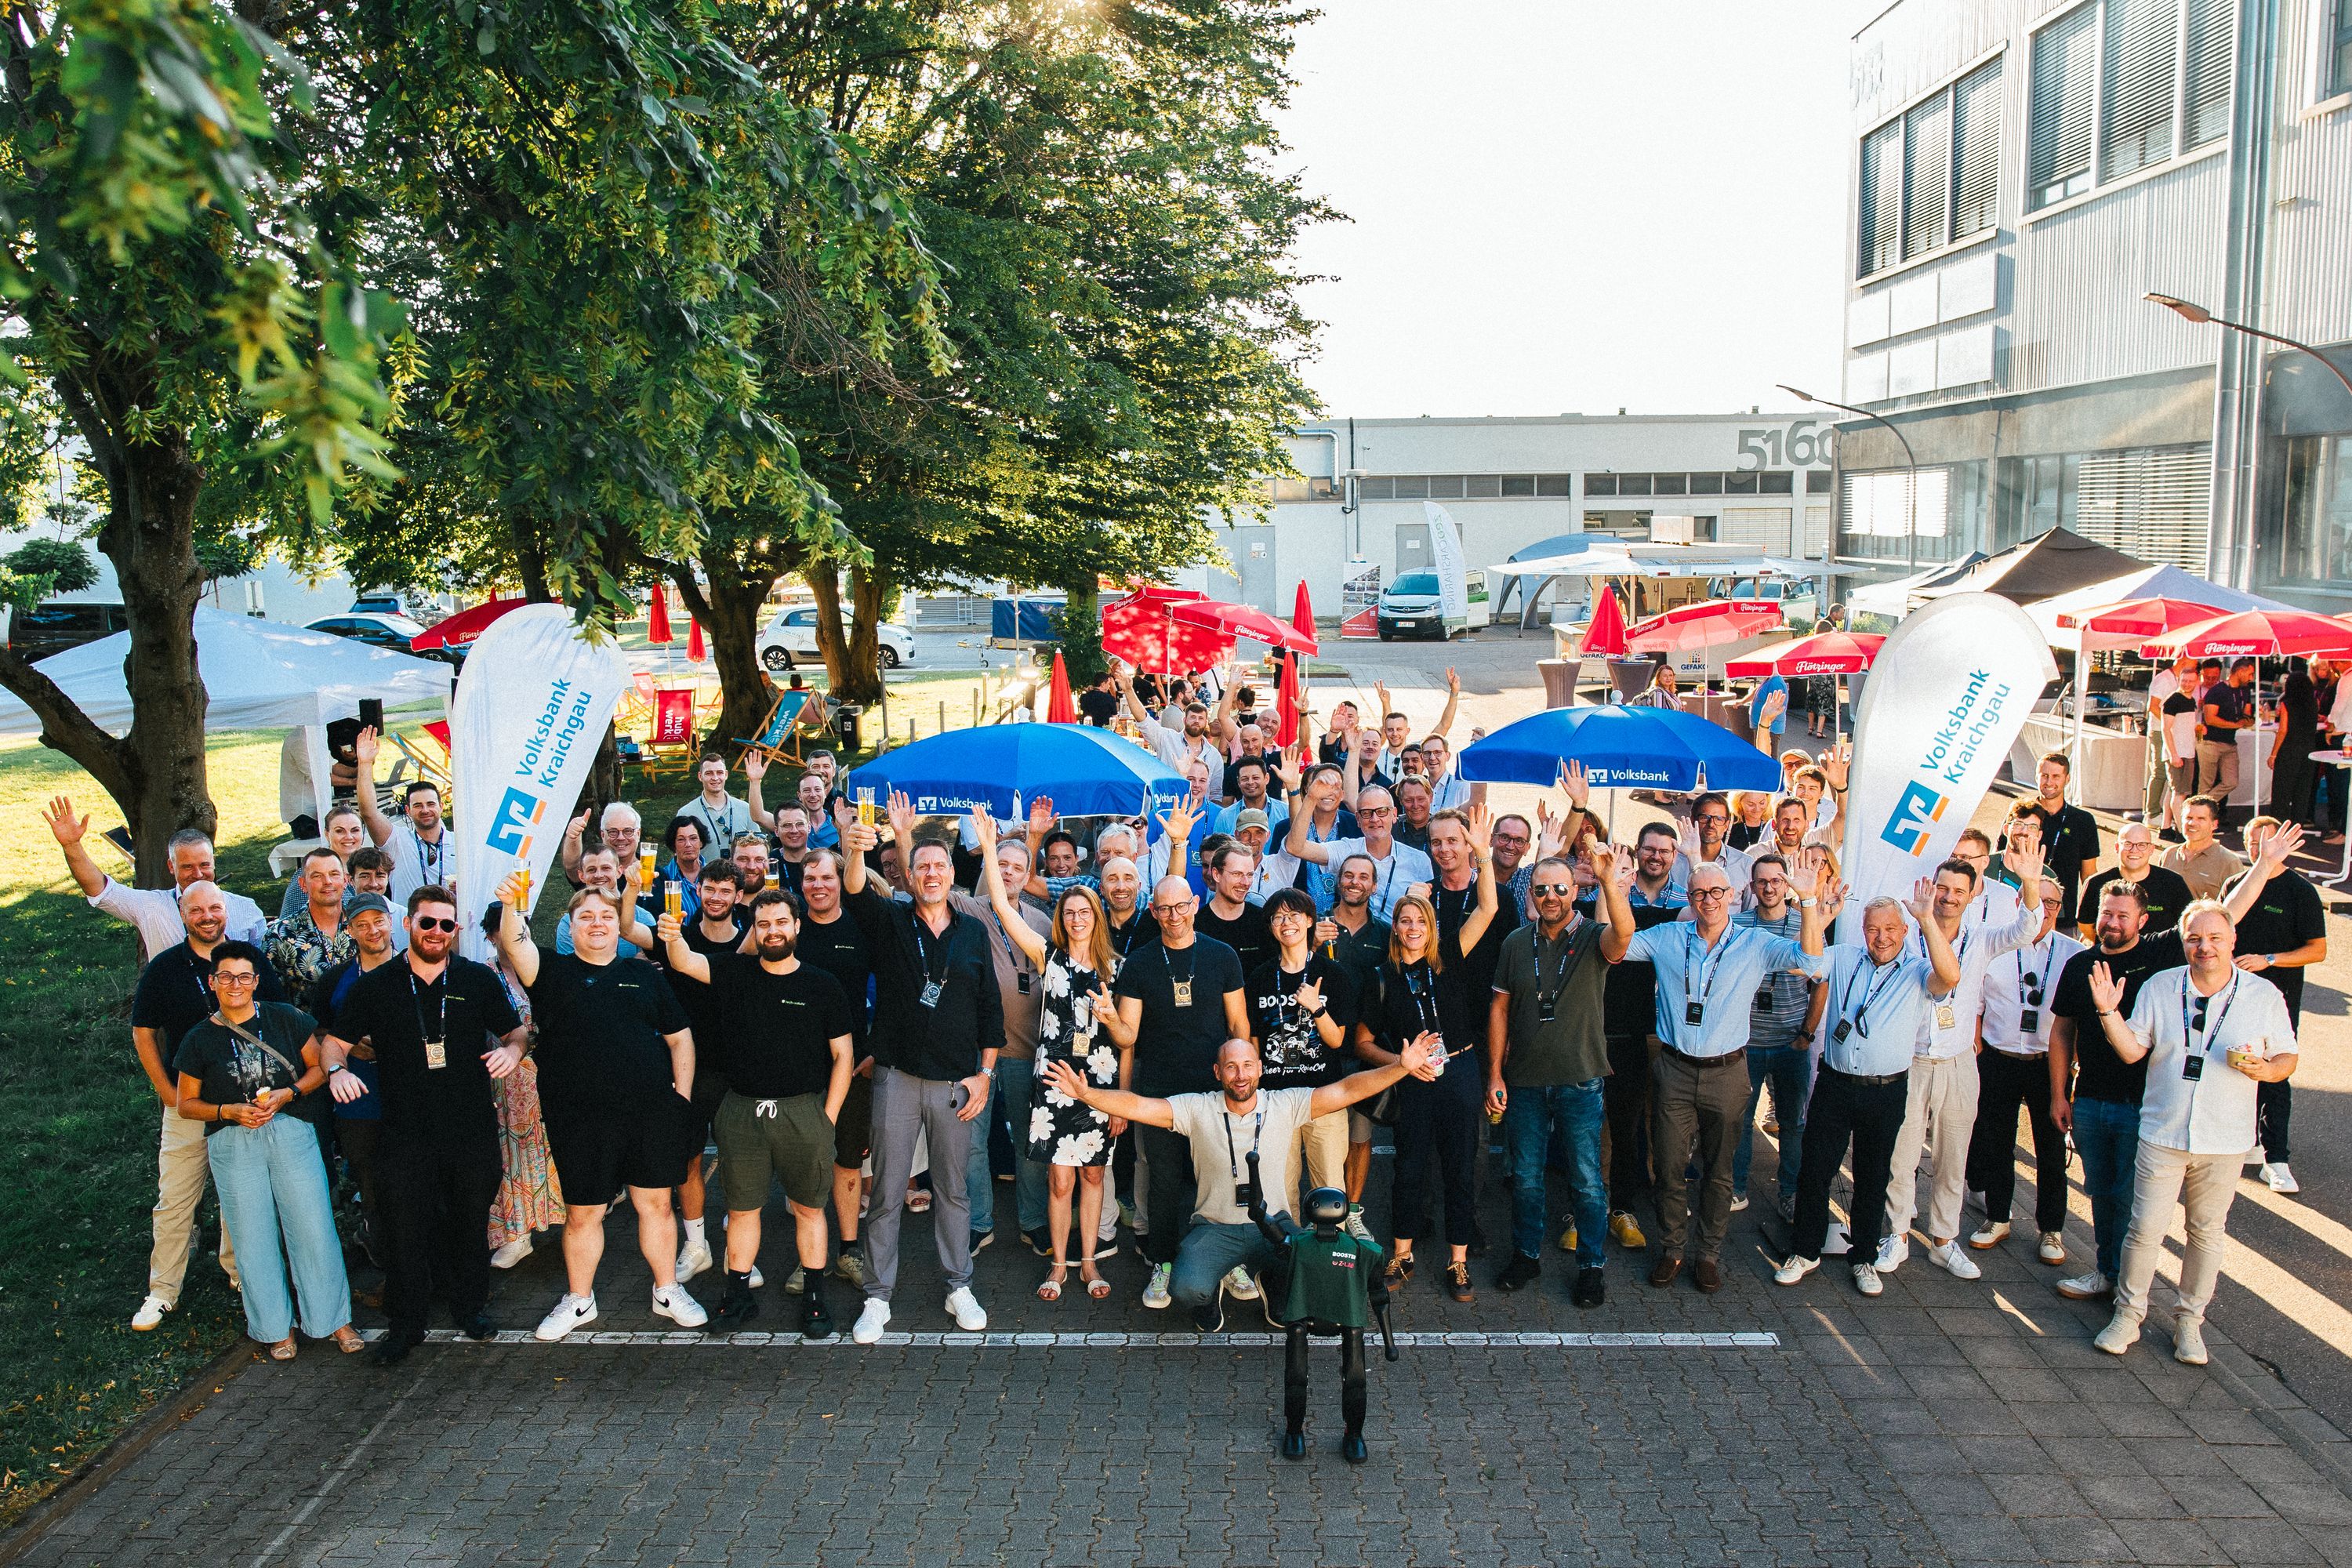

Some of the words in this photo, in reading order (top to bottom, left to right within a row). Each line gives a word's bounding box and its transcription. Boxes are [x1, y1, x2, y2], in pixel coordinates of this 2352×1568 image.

[1234, 624, 1271, 640] Flötzinger
[2204, 642, 2256, 655] Flötzinger
[1795, 660, 1846, 673] Flötzinger
[514, 677, 572, 776] Volksbank
[664, 709, 674, 735] werk
[674, 716, 685, 735] hub
[1919, 668, 1991, 770] Volksbank
[538, 691, 592, 789] Kraichgau
[1943, 684, 2011, 785] Kraichgau
[1610, 768, 1669, 782] Volksbank
[1258, 994, 1328, 1009] BOOSR
